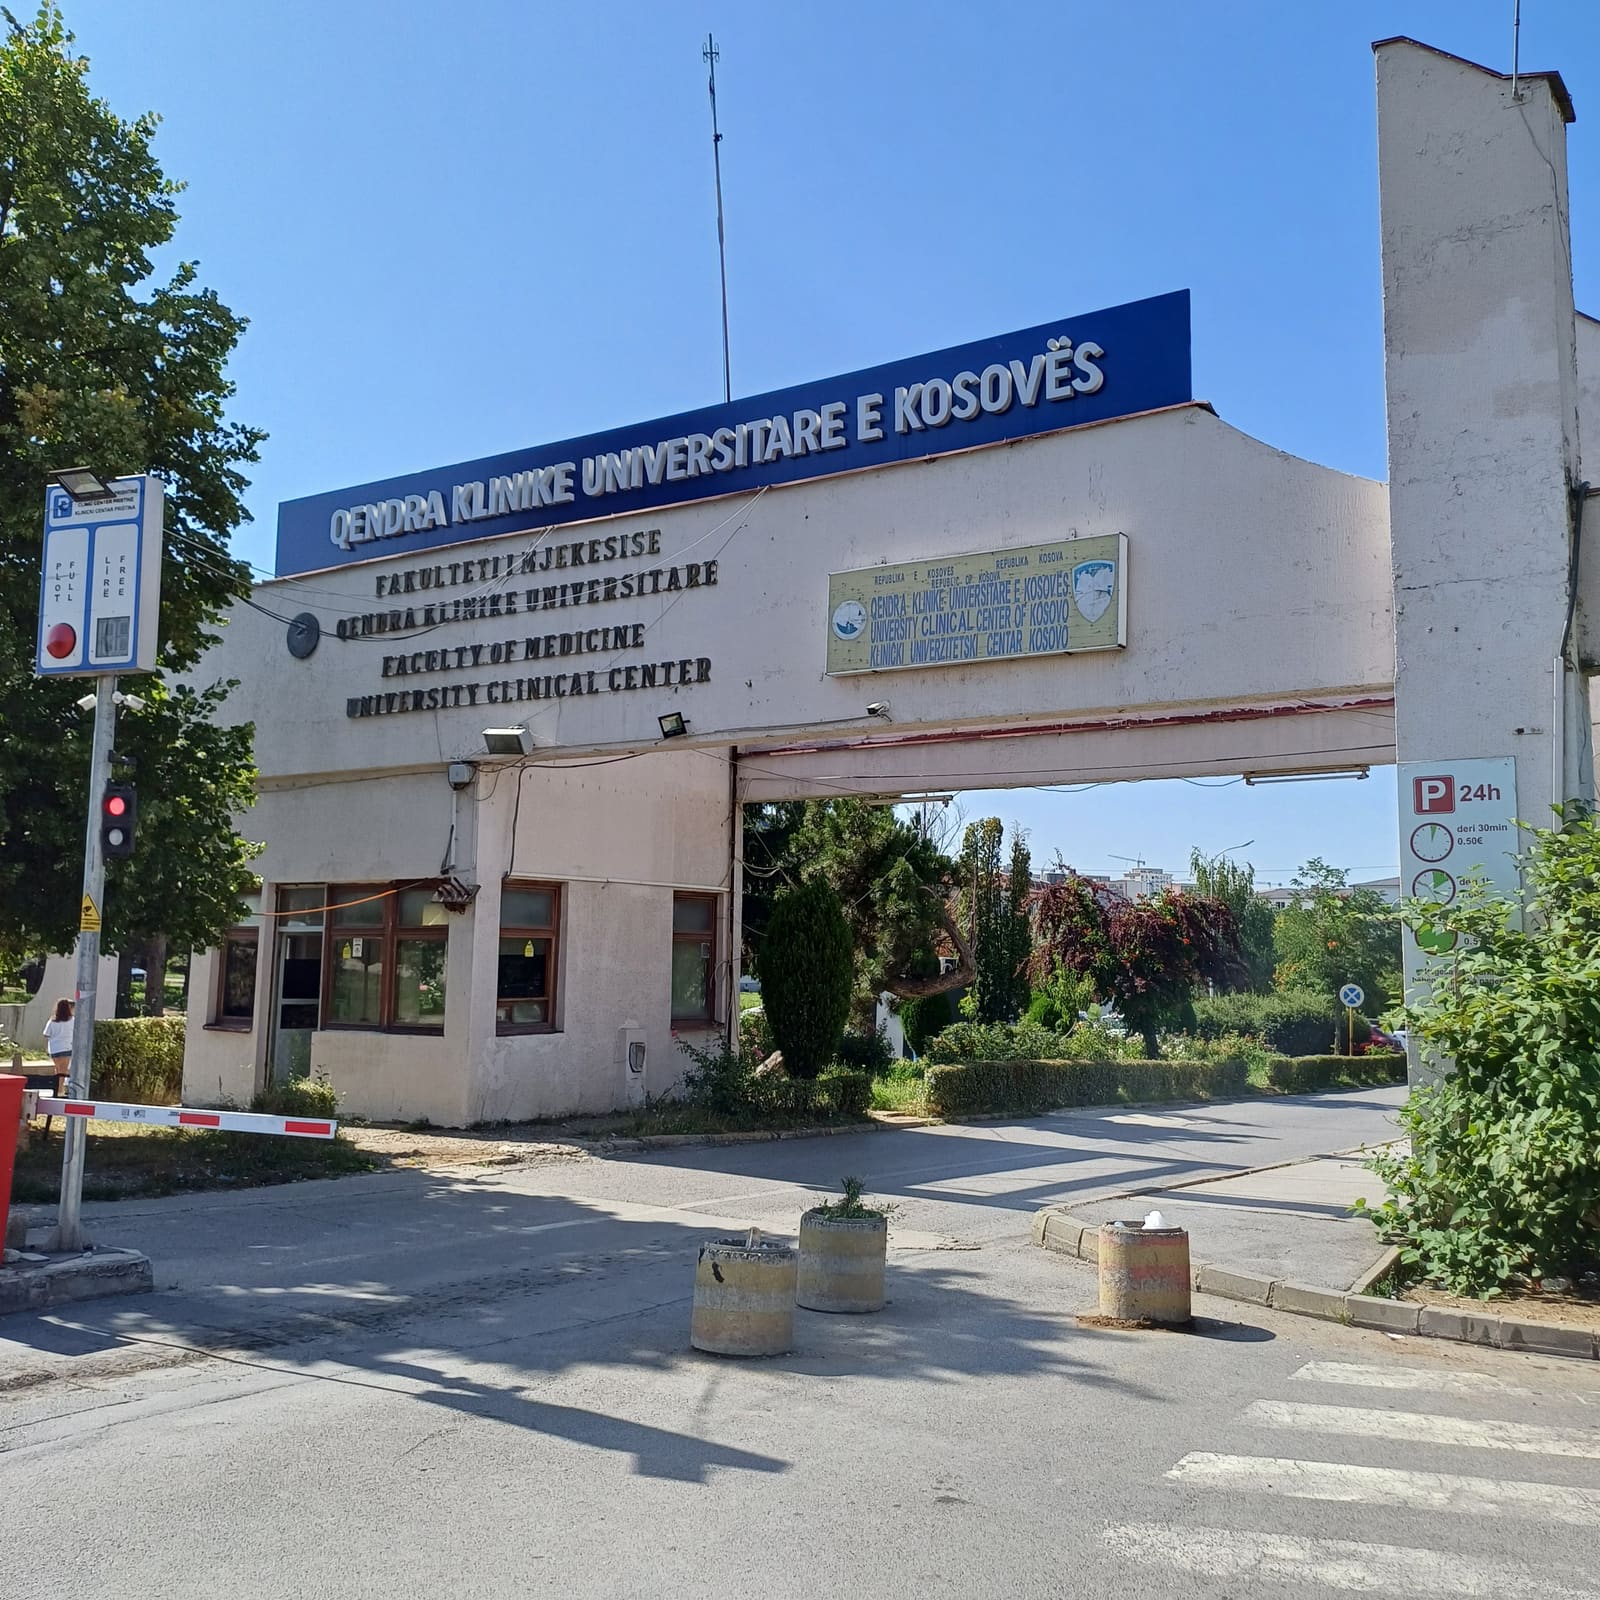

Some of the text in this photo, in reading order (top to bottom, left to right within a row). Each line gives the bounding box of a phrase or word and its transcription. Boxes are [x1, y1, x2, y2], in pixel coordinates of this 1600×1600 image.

[330, 335, 1104, 550] QENDRA KLINIKE UNIVERSITARE E KOSOVËS
[118, 555, 126, 596] FREE
[875, 573, 905, 585] REPUBLIKA
[996, 551, 1064, 569] REPUBLIKA KOSOVA
[54, 562, 62, 602] PLOT
[336, 559, 718, 642] QENDRA KLINIKE UNIVERSITARE
[870, 593, 907, 620] QENDRA
[912, 589, 944, 614] KLINIKE
[949, 580, 1012, 610] UNIVERSITARE
[1014, 578, 1021, 603] E
[870, 598, 1070, 644] UNIVERSITY CLINICAL CENTER OF KOSOVO
[986, 629, 1023, 656] CENTAR
[1029, 624, 1069, 652] KOSOVO
[381, 623, 646, 678] FACULTY OF MEDICINE
[346, 657, 712, 718] UNIVERSITY CLINICAL CENTER
[1421, 780, 1501, 811] P 24h
[1457, 823, 1508, 833] deri 30min
[1457, 836, 1483, 846] 0.50€
